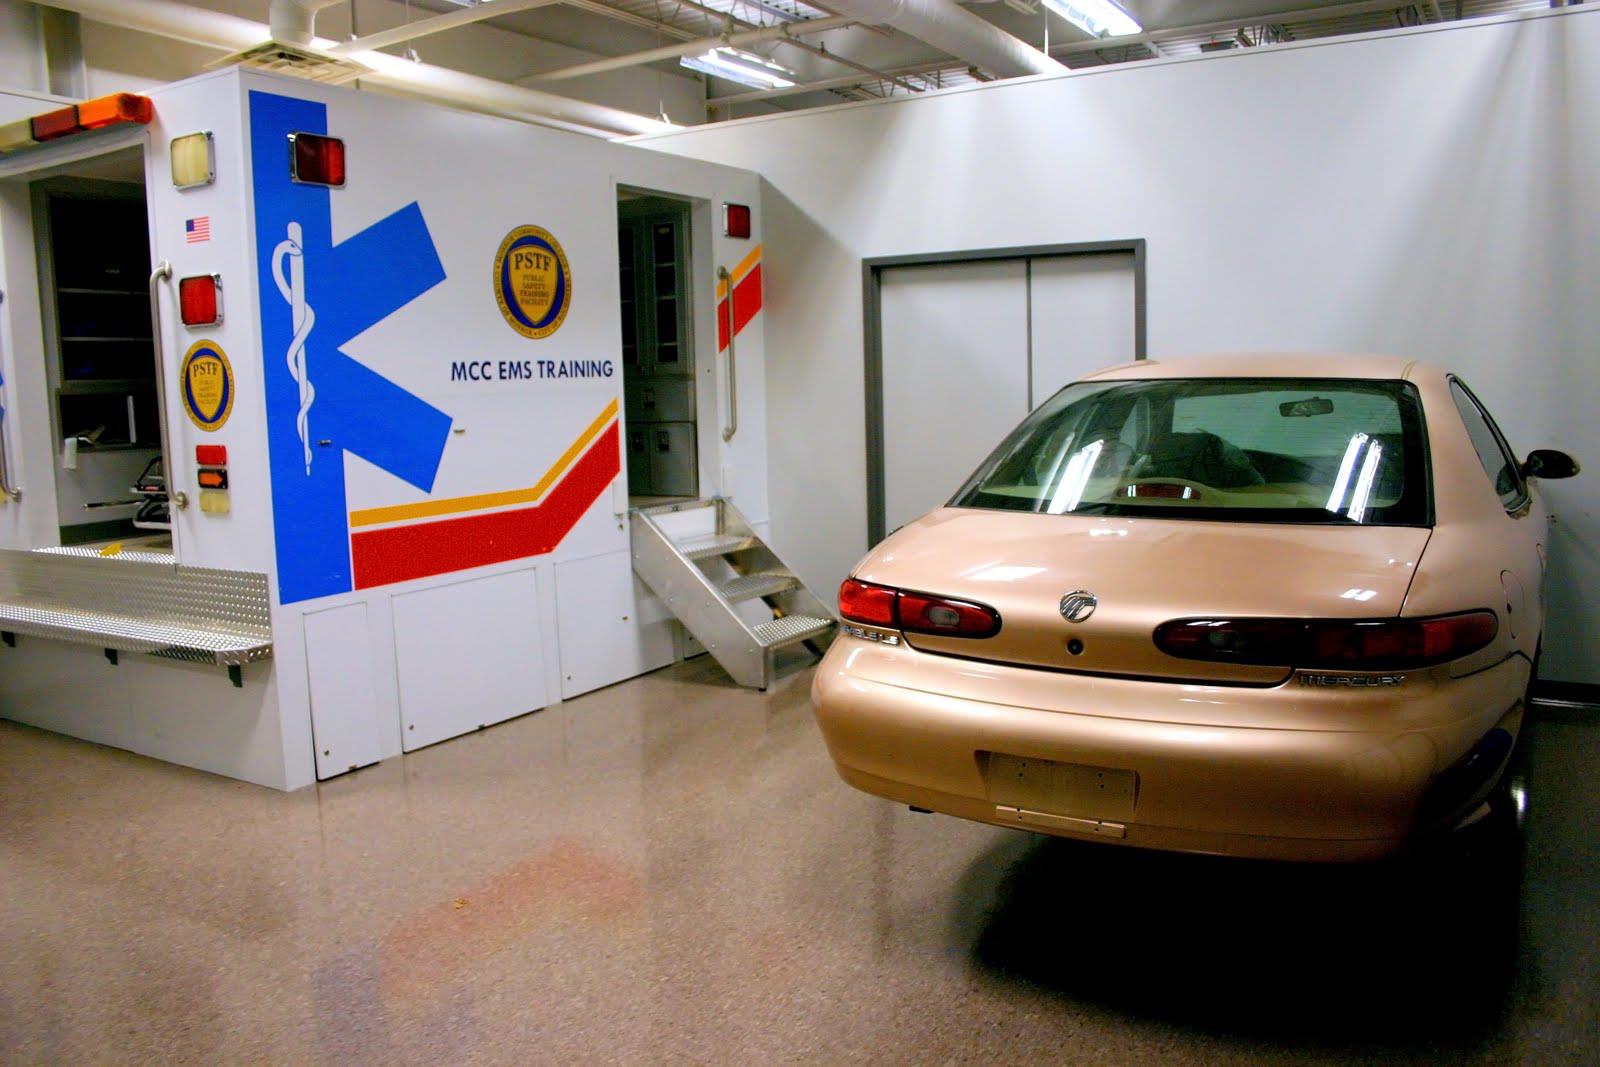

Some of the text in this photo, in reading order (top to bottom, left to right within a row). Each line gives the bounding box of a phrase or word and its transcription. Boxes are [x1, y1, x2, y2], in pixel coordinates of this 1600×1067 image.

[514, 251, 552, 272] PSTF
[193, 361, 218, 377] PSTF
[451, 360, 613, 381] MCC EMS TRAINING
[1299, 674, 1405, 687] MERCURY
